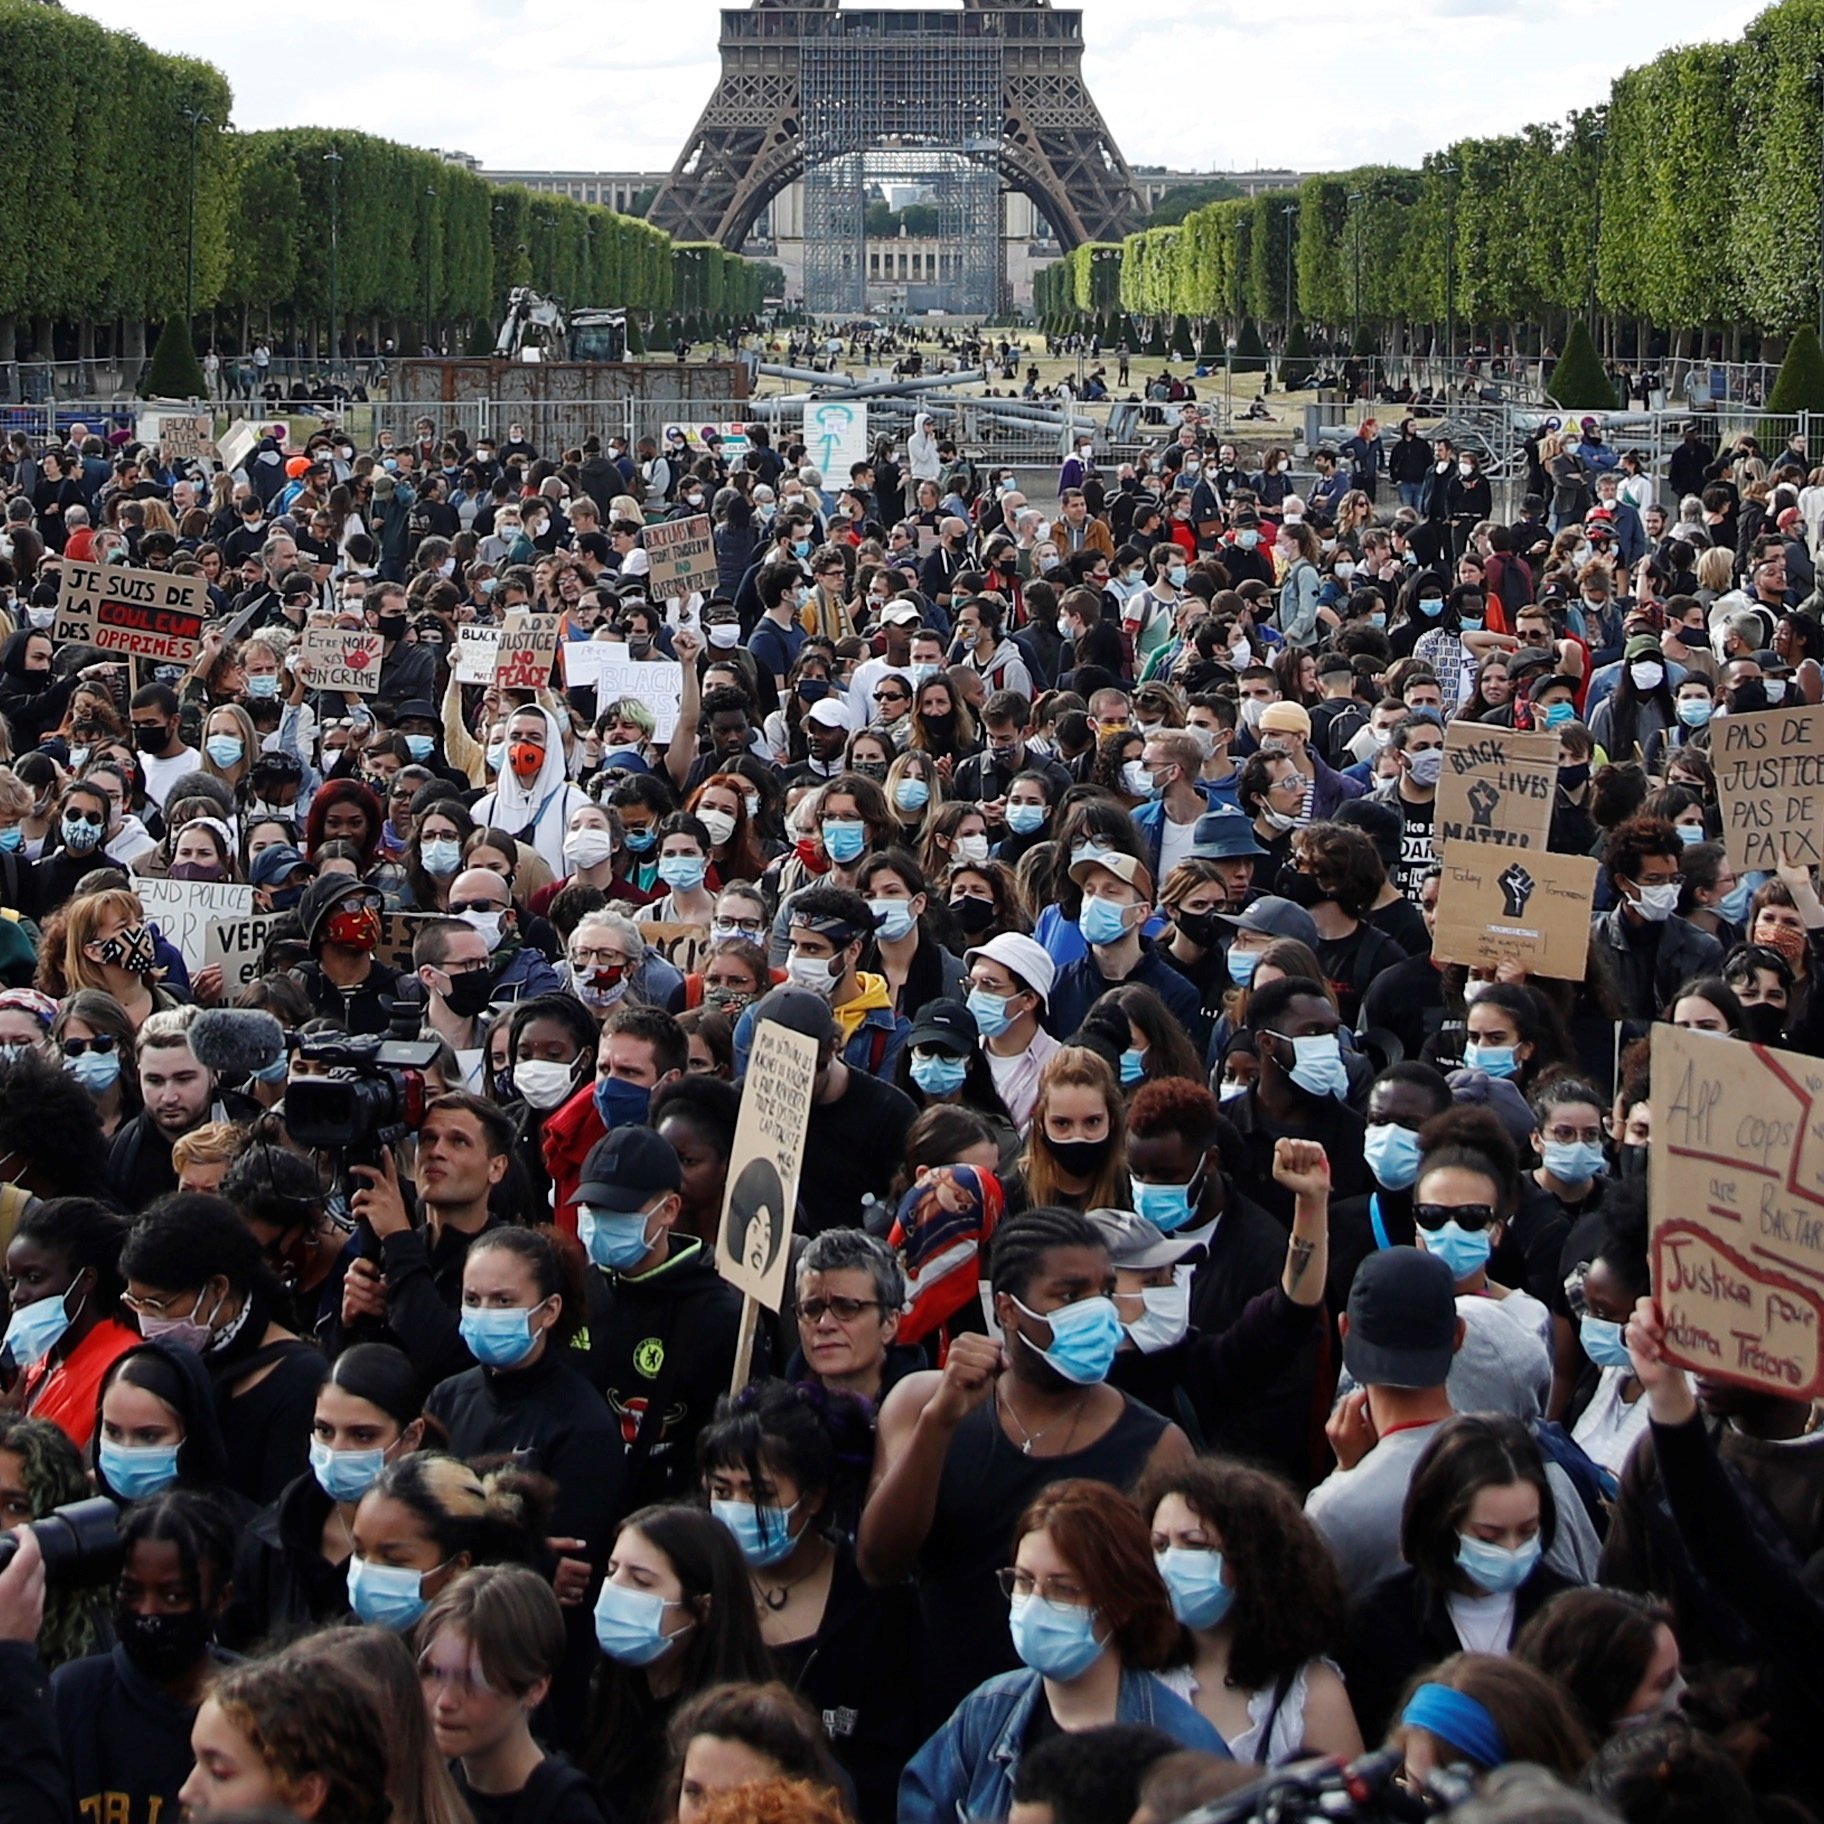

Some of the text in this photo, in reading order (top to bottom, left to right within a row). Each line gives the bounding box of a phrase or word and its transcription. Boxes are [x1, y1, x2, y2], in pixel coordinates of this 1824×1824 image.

[67, 569, 195, 608] JE SUIS DE
[66, 595, 199, 639] LA COULEUR
[58, 620, 194, 660] DES OPPRIMÉS
[461, 627, 499, 641] BLACK
[499, 633, 554, 650] JUSTICE
[511, 650, 535, 666] NO
[330, 669, 377, 690] CRIME
[497, 665, 550, 688] PEACE
[601, 666, 681, 694] BLACK
[1725, 717, 1814, 751] PAS DE
[1450, 738, 1506, 775] BLACK
[1498, 771, 1549, 799] LIVES
[1732, 796, 1814, 828] PAS DE
[1444, 821, 1529, 849] MATTER
[1744, 828, 1821, 865] PAIX
[1447, 866, 1482, 890] Today
[136, 879, 251, 911] END POLICE
[1736, 1112, 1794, 1173] cops
[1709, 1176, 1739, 1204] are
